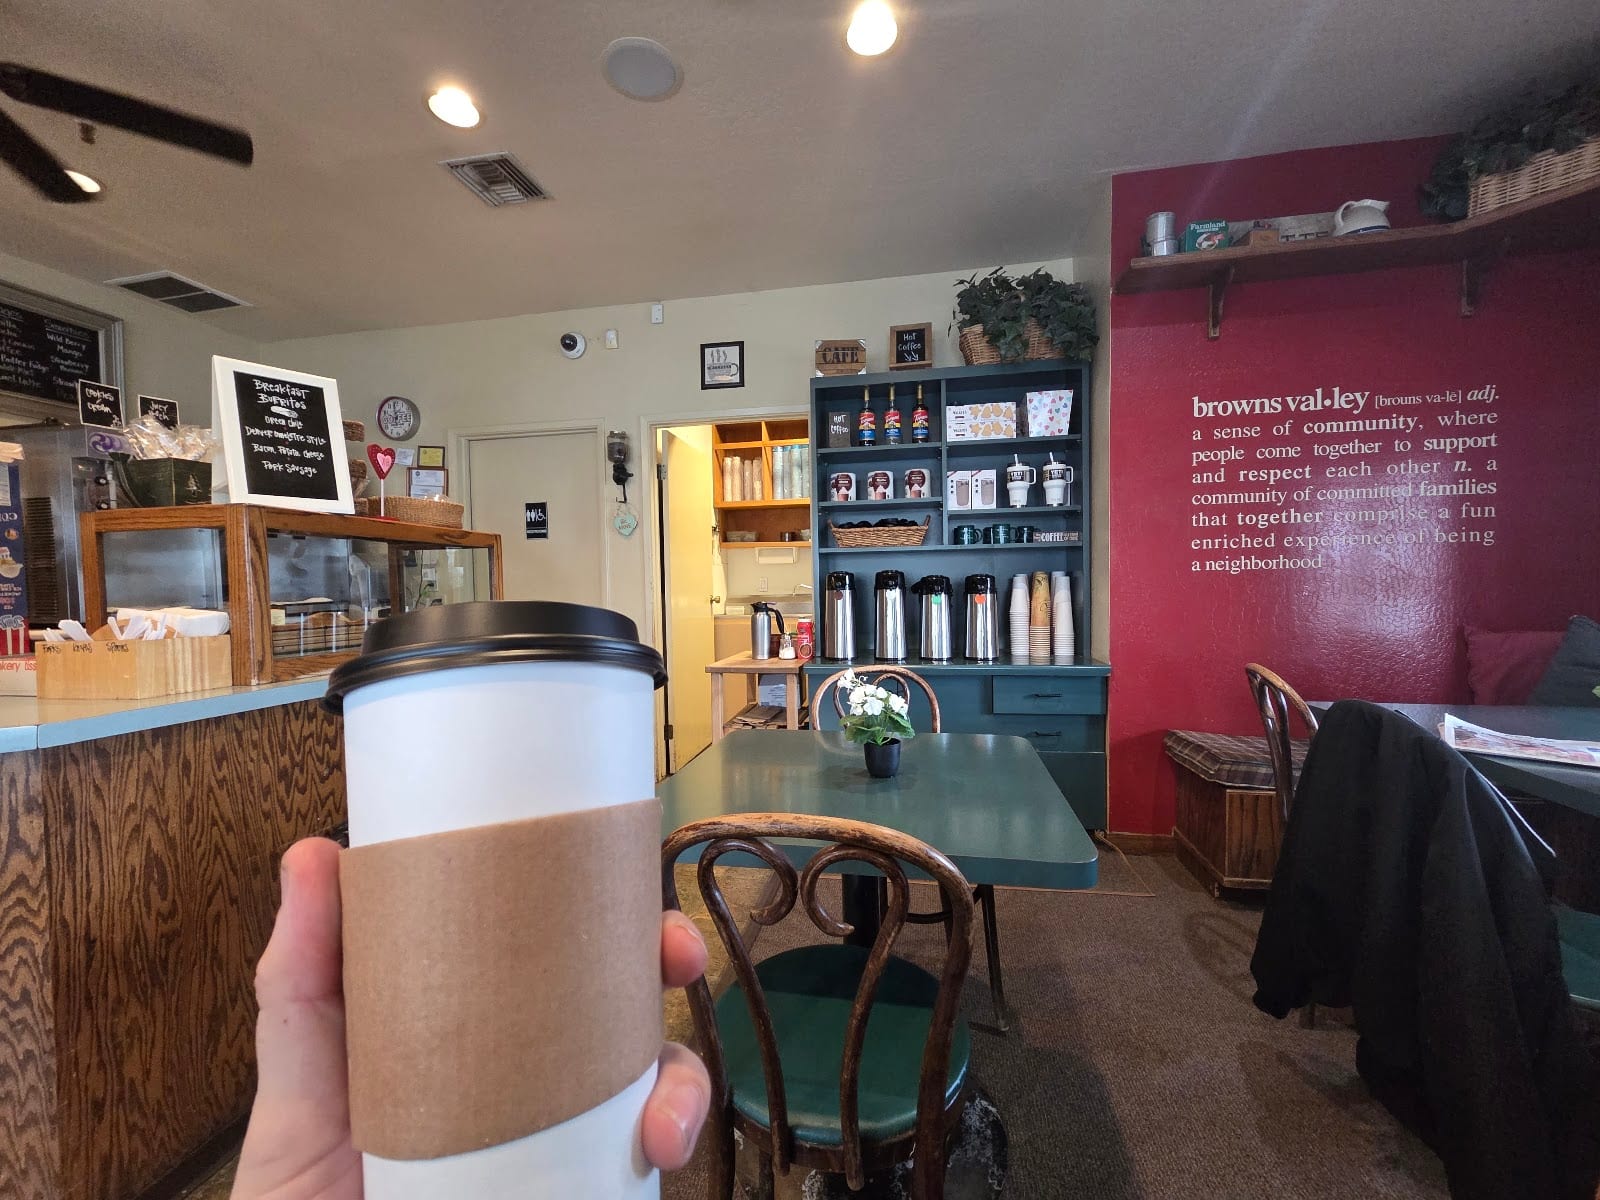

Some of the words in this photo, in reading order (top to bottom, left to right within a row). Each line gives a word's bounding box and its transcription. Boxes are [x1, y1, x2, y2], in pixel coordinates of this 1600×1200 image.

[1190, 219, 1226, 231] Farmland
[1192, 395, 1282, 418] browns
[1466, 384, 1500, 403] adj.
[1192, 428, 1203, 440] a
[1213, 425, 1261, 440] sense
[1272, 419, 1293, 436] of
[1303, 414, 1425, 435] community,
[1437, 410, 1498, 428] where
[1192, 445, 1245, 466] people
[1256, 445, 1301, 459] come
[1313, 440, 1382, 460] together
[1394, 439, 1411, 453] to
[1423, 433, 1498, 454] support
[1192, 467, 1226, 484] and
[1239, 464, 1312, 485] respect
[1326, 461, 1372, 478] each
[1386, 459, 1440, 476] other
[1454, 460, 1472, 472] n.
[1486, 459, 1498, 471] a
[1192, 484, 1287, 506] community
[1293, 485, 1314, 501] of
[1316, 483, 1412, 500] committed
[1419, 479, 1498, 497] families
[1192, 511, 1228, 527] that
[1237, 507, 1323, 529] together
[1333, 505, 1428, 524] comprise
[1438, 507, 1450, 520] a
[1460, 502, 1496, 518] fun
[1191, 532, 1276, 550] enriched
[1283, 532, 1395, 551] experience
[1404, 528, 1427, 545] of
[1435, 526, 1496, 546] being
[1191, 560, 1201, 572] a
[1205, 553, 1323, 575] neighborhood
